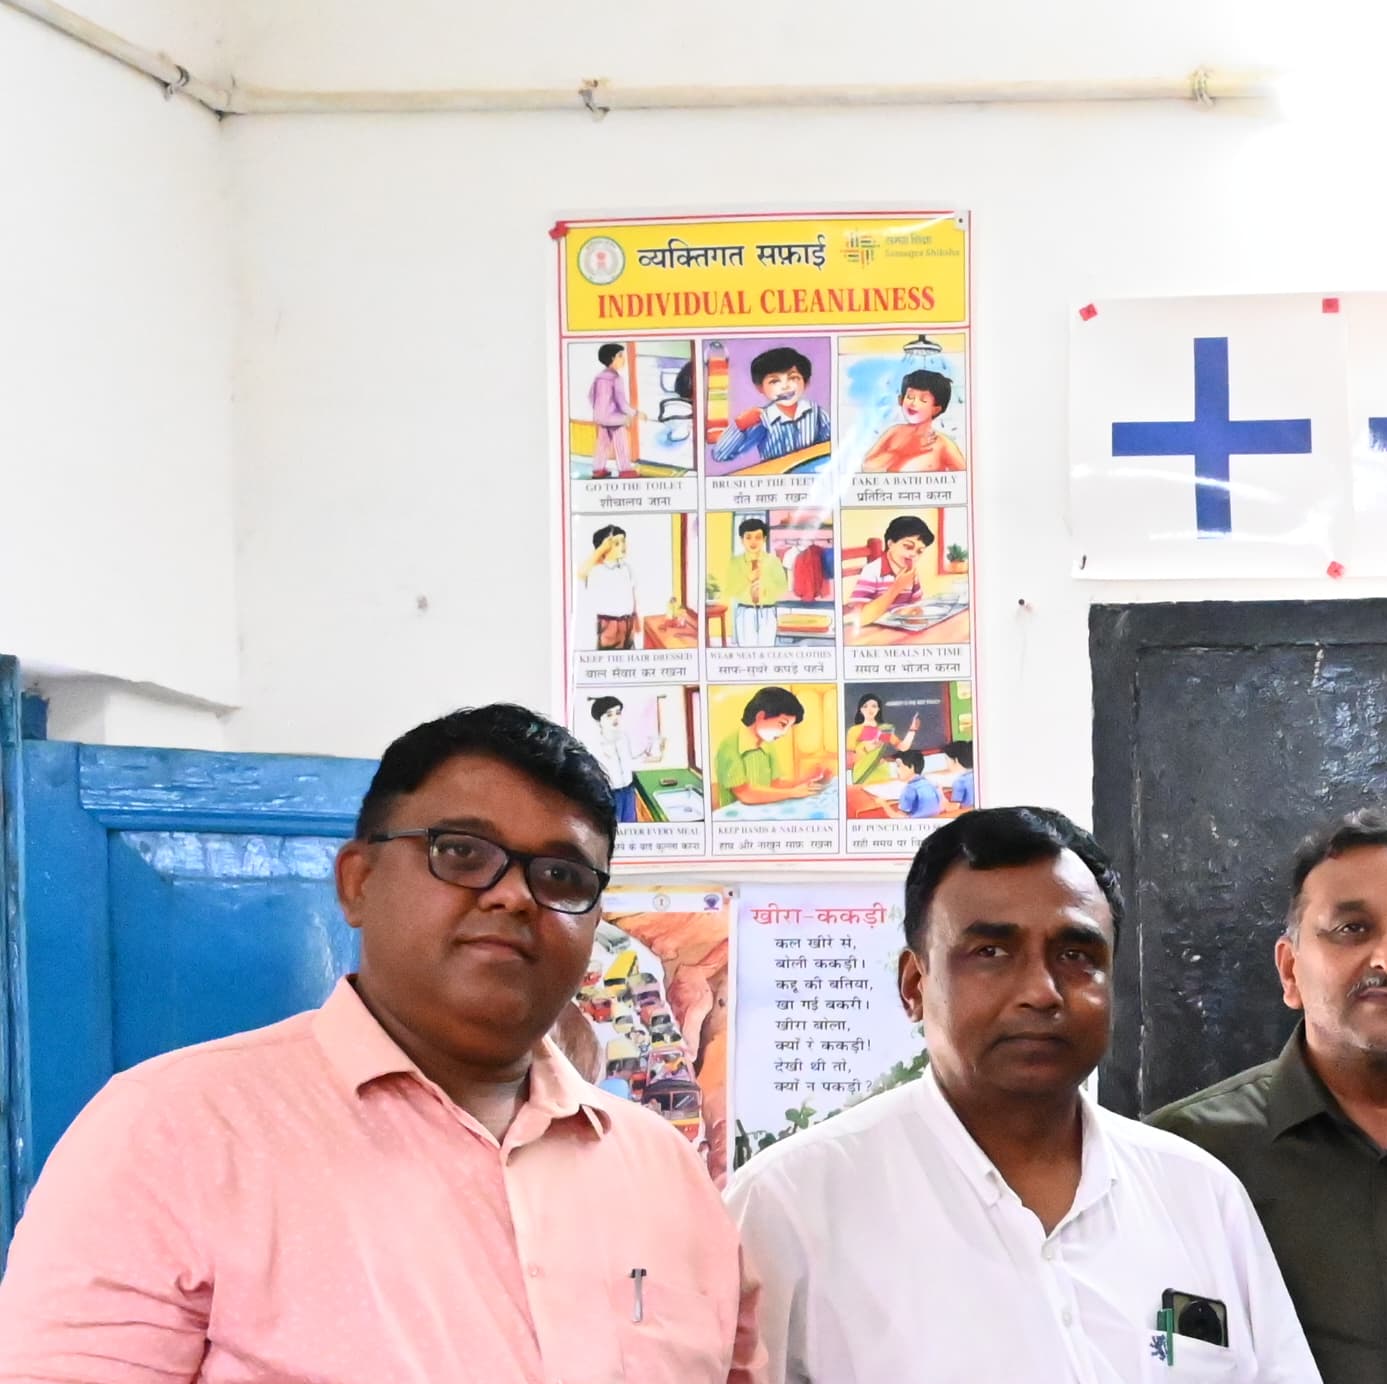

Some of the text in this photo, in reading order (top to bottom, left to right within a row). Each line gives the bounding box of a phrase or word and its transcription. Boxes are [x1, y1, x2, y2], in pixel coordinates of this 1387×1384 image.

[636, 238, 745, 269] व्यक्तिगत
[598, 285, 936, 319] INDIVIDUAL CLEANLINESS
[585, 480, 684, 492] GO TO THE TOILET
[711, 479, 747, 489] BRUSH
[750, 478, 765, 488] UP
[766, 477, 785, 488] THE
[851, 474, 958, 487] TAKE A BATH DAILY
[648, 496, 672, 507] जाना
[856, 488, 893, 502] प्रतिदिन
[926, 490, 952, 501] करना
[851, 646, 962, 659] TAKE MEALS IN TIME
[640, 667, 657, 678] कर
[855, 661, 961, 674] समय पर भोजन करना
[865, 823, 914, 833] PUNCTUAL
[774, 938, 801, 949] कल
[806, 934, 834, 949] खीरे
[774, 955, 808, 969] बोली
[804, 976, 823, 990] की
[774, 999, 795, 1011] खा
[799, 996, 819, 1011] गई
[774, 1017, 808, 1031] खीरा
[774, 1037, 801, 1051] क्यों
[804, 1037, 815, 1051] रे
[773, 1058, 803, 1072] देखी
[809, 1058, 827, 1071] थी
[773, 1078, 800, 1092] क्यों
[805, 1080, 816, 1092] न
